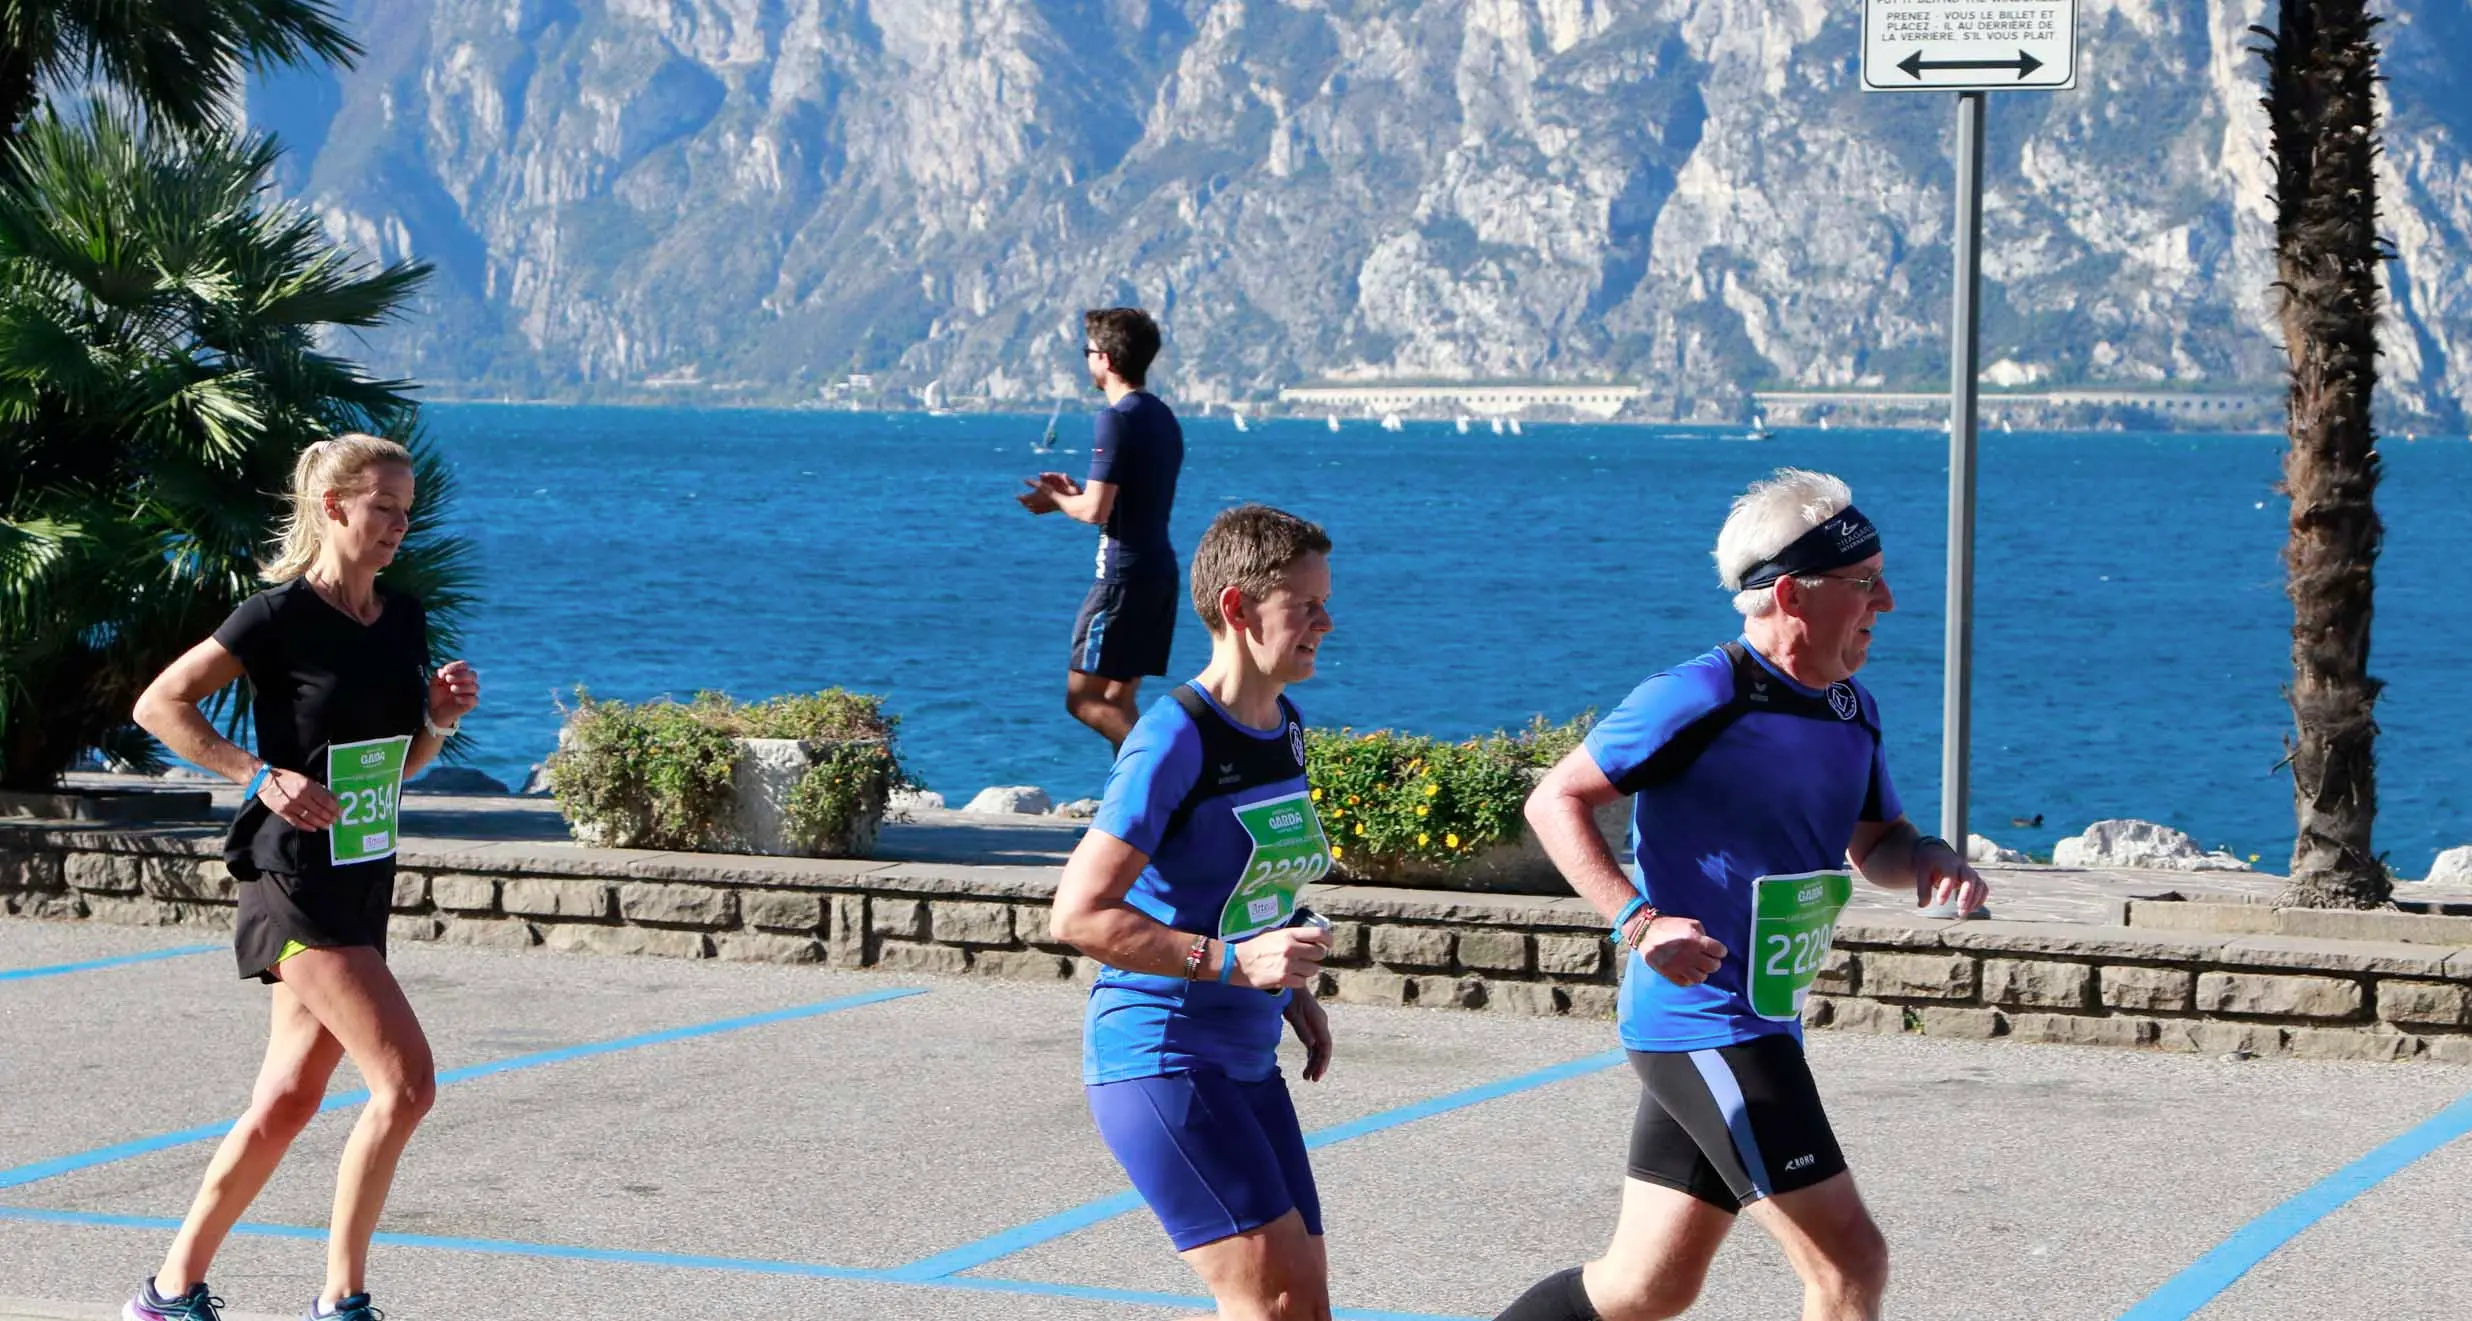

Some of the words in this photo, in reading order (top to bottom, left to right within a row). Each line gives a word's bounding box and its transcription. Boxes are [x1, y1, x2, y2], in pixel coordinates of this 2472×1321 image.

[1887, 12, 1929, 20] PRENEZ
[1944, 11, 1975, 20] VOUS
[1980, 11, 1993, 19] LE
[1999, 11, 2035, 19] BILLET
[2040, 10, 2054, 19] ET
[1887, 22, 1929, 31] PLACEZ
[1944, 22, 1953, 30] IL
[1958, 21, 1973, 30] AU
[2038, 20, 2053, 29] DE
[1881, 33, 1896, 41] LA
[1987, 31, 2018, 40] VOUS
[339, 783, 395, 826] 2354
[1766, 923, 1830, 976] 2229
